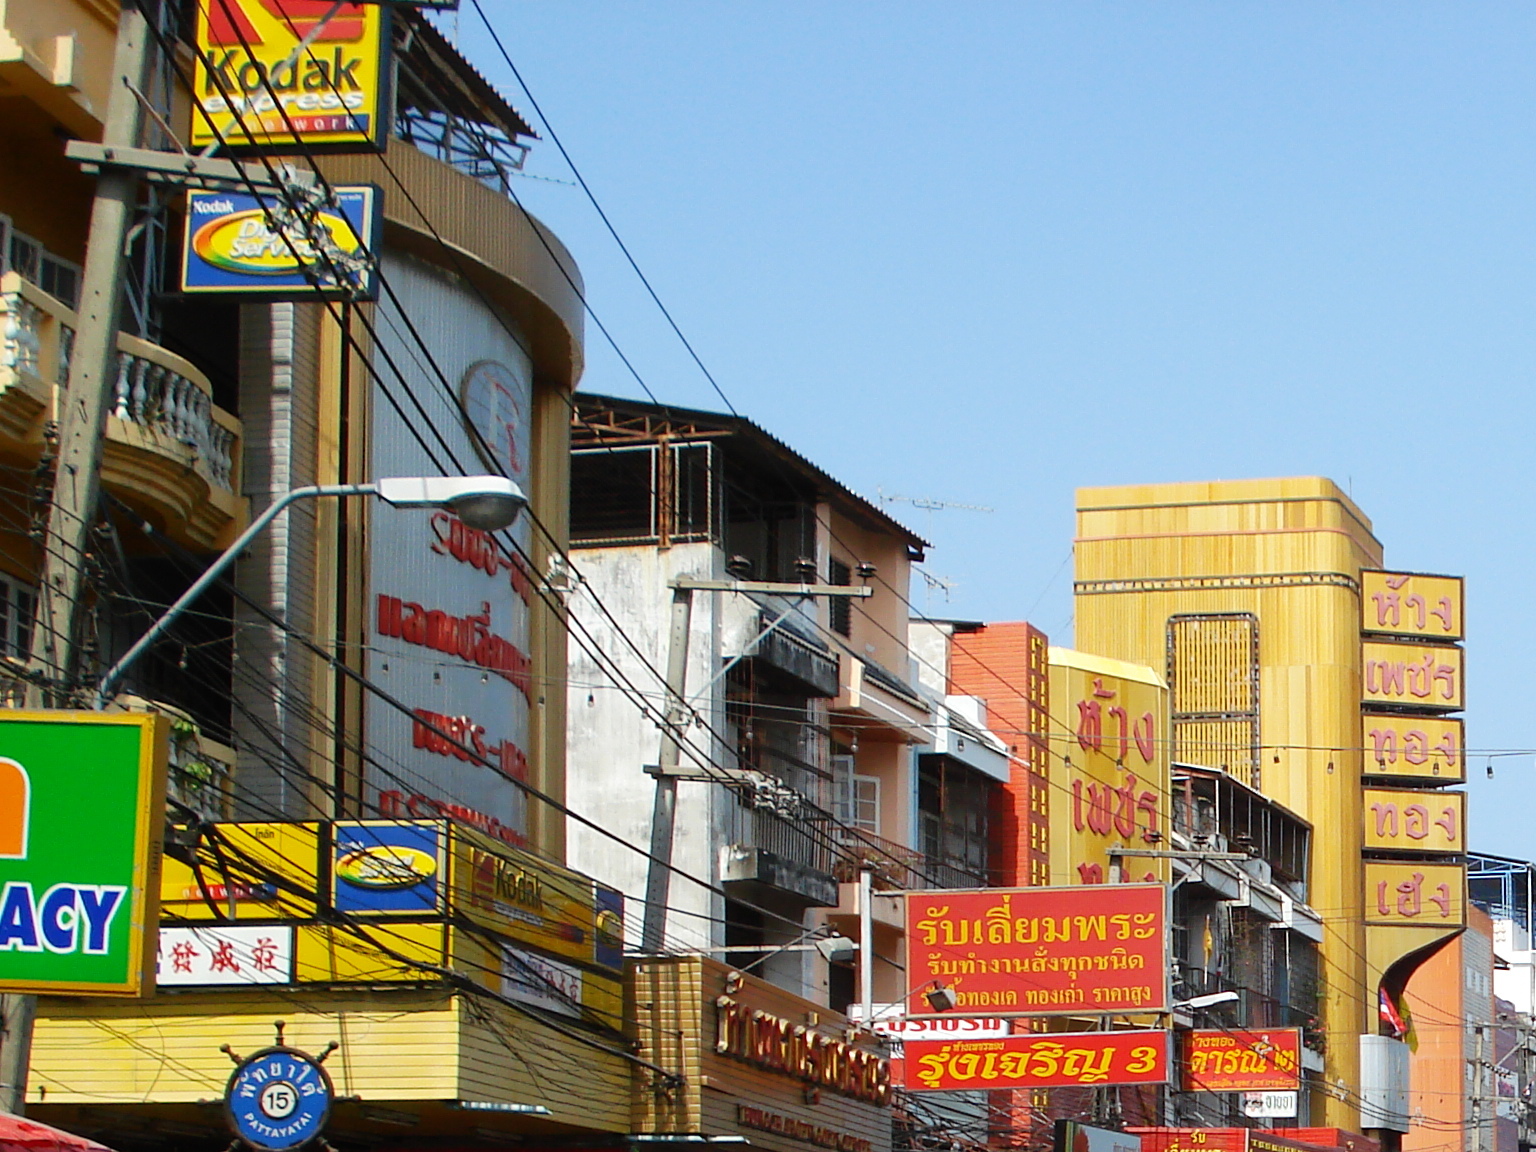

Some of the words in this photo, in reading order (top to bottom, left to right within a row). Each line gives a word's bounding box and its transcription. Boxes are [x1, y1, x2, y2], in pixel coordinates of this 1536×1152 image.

[206, 46, 361, 95] Kodak
[204, 92, 364, 114] express
[193, 200, 235, 214] Kodak
[1371, 575, 1454, 632] ห้าง
[1366, 653, 1456, 700] เพชร
[1075, 678, 1155, 763] ห้าง
[1368, 725, 1457, 767] ทอง
[1071, 773, 1160, 844] เพชร
[1369, 801, 1457, 842] ทอง
[916, 895, 1156, 945] รับเลี่ยมพระ
[927, 946, 1145, 980] รับทำงานสั่งทุกชนิด
[1025, 983, 1084, 1005] ทองเก่า
[1093, 983, 1151, 1006] ราคาสูง
[240, 1062, 325, 1098] พัทยาใต้
[916, 1041, 1117, 1088] รุ่งเจริญ
[1126, 1046, 1158, 1074] 3
[267, 1092, 289, 1110] 15
[244, 1112, 313, 1138] PATTAYATAI
[1190, 1128, 1206, 1144] รับ
